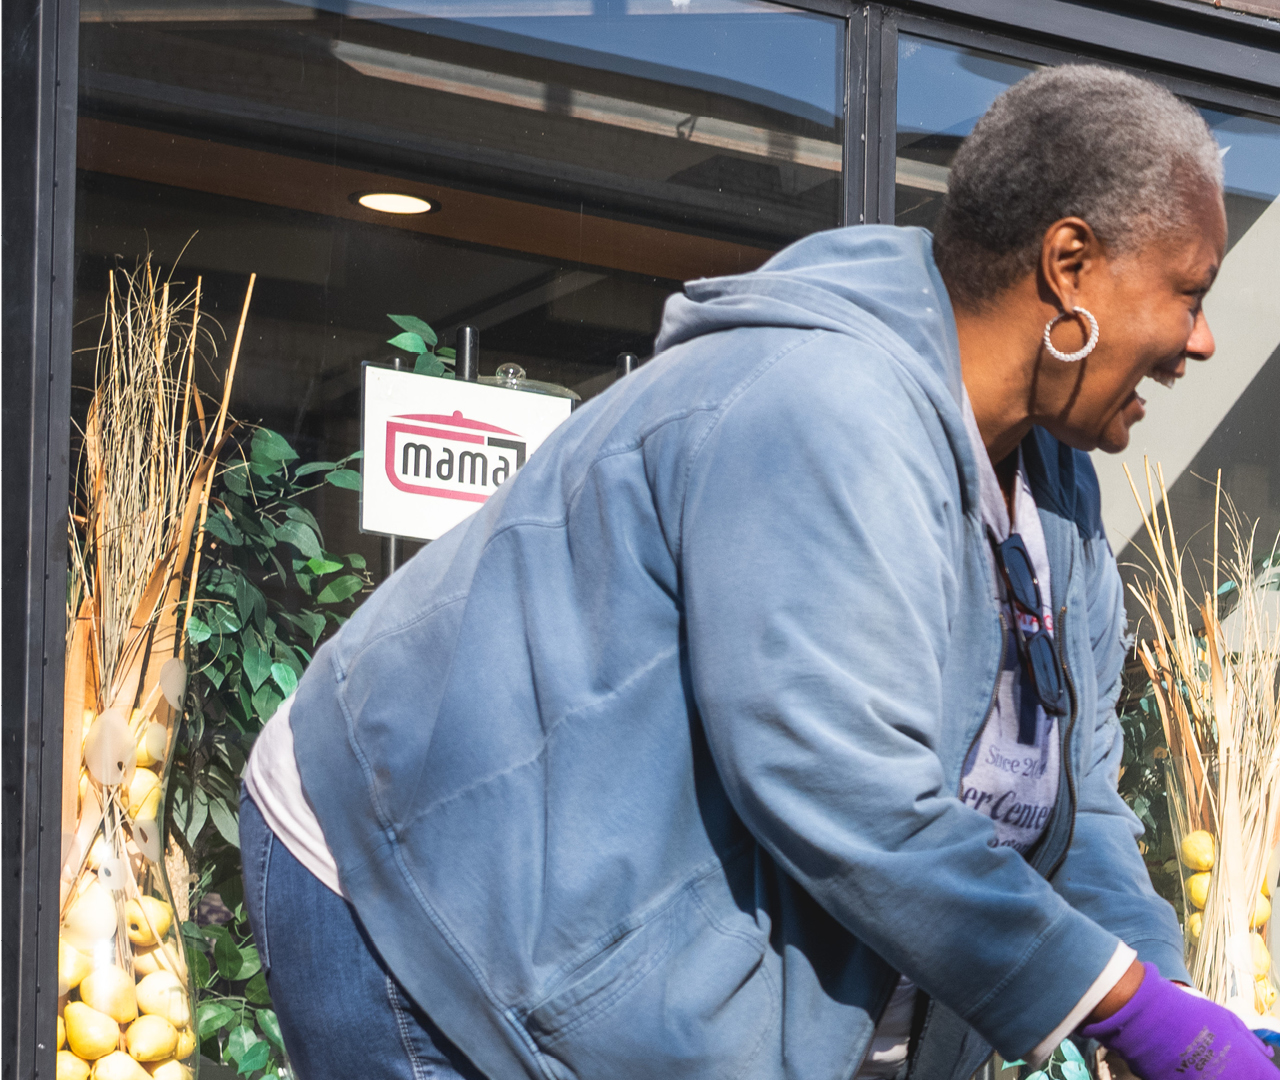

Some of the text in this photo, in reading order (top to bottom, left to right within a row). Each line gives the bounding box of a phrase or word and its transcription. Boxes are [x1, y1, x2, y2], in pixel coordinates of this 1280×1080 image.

[961, 787, 1049, 830] er Cente
[1174, 1032, 1216, 1074] WONDER
[1194, 1048, 1215, 1072] GRIP
